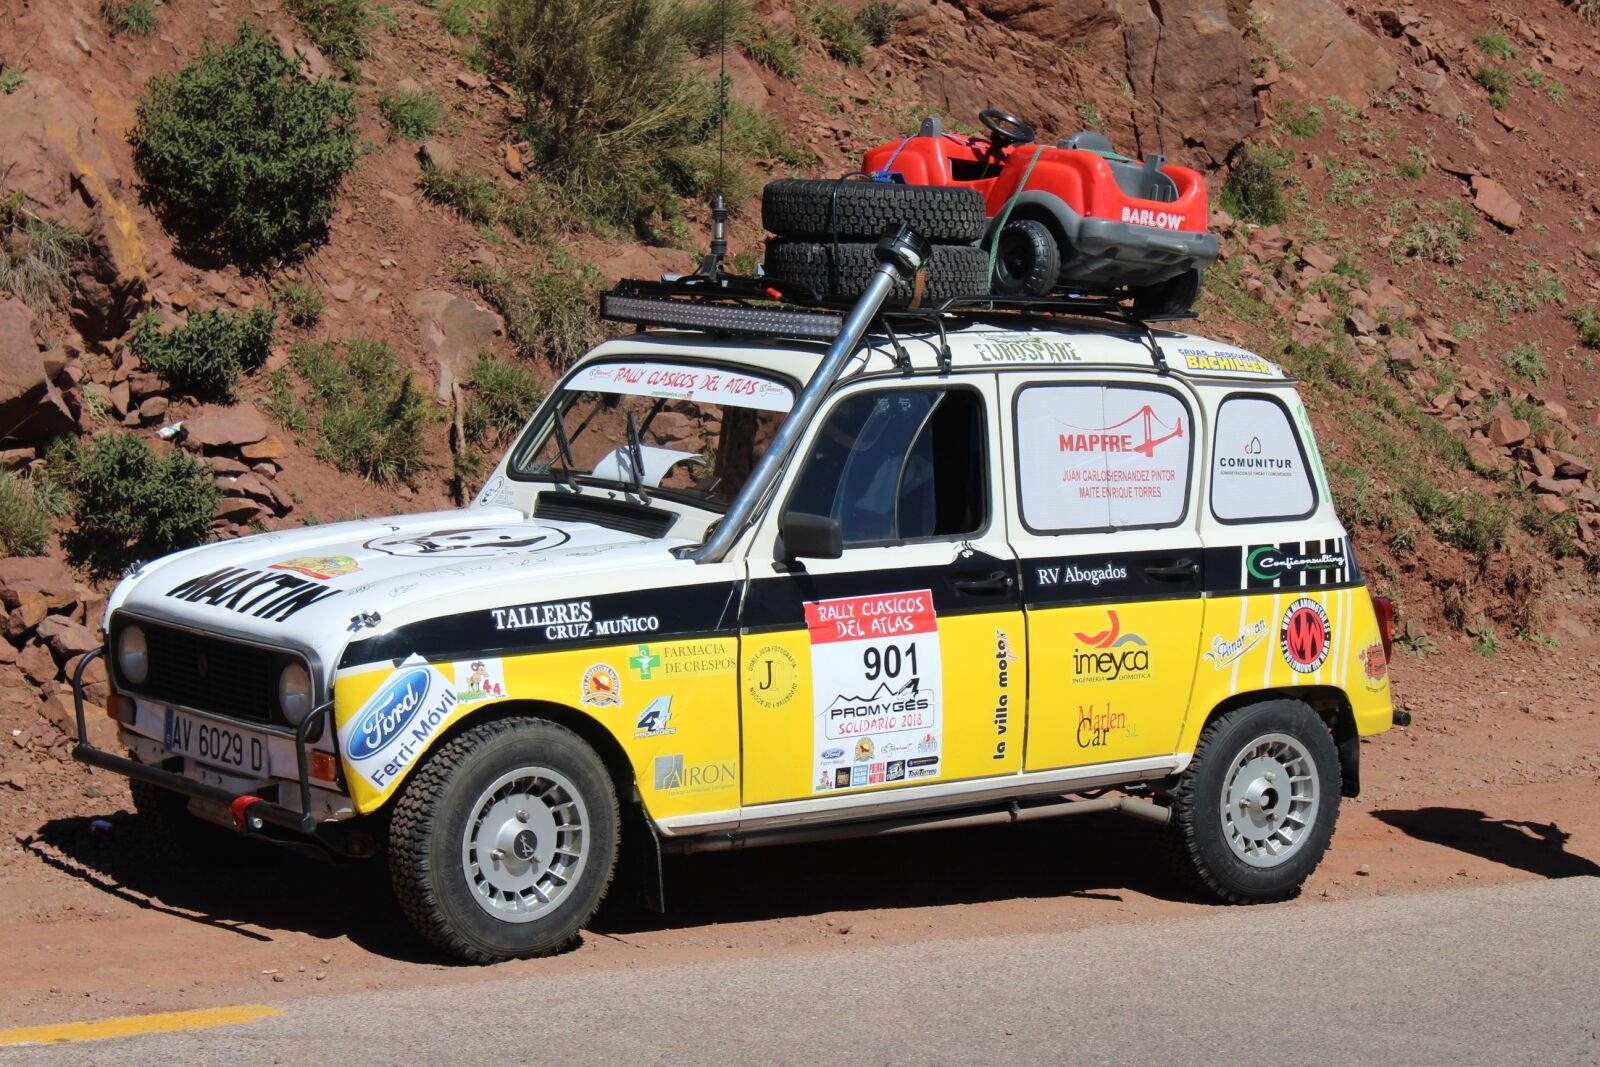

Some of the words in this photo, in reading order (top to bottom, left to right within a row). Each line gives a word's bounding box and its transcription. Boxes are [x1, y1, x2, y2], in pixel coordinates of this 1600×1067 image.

[1121, 206, 1182, 231] BARLOW
[973, 342, 1082, 361] EUROSPARE
[1184, 355, 1273, 376] BACHILLER
[613, 367, 647, 383] RALLY
[647, 370, 699, 388] CLASICOS
[699, 374, 720, 392] DEL
[723, 377, 760, 395] ATLAS
[1059, 434, 1133, 453] MAPFRE
[1219, 457, 1292, 469] COMUNITUR
[1062, 470, 1081, 482] JUAN
[1151, 470, 1176, 481] PINTOR
[1079, 487, 1100, 498] MAITE
[1102, 486, 1133, 498] ENRIQUE
[1134, 487, 1162, 498] TORRES
[1260, 554, 1345, 570] Conficonsulting
[1037, 568, 1060, 585] RV
[1064, 563, 1127, 586] Abogados
[491, 601, 593, 630] TALLERES
[817, 602, 855, 622] RALLY
[862, 597, 925, 616] CLASICOS
[596, 616, 659, 636] MUÑICO
[837, 619, 865, 638] DEL
[871, 615, 915, 635] ATLAS
[664, 643, 726, 658] FARMACIA
[863, 642, 917, 681] 901
[665, 662, 682, 673] DE
[684, 658, 737, 672] CRESPOS
[760, 660, 774, 690] J
[1073, 648, 1149, 681] imeyca
[362, 682, 419, 749] Ford
[830, 698, 929, 720] PROMYGES
[994, 694, 1008, 735] villa
[1078, 702, 1126, 732] Marlen
[838, 716, 897, 735] SOLIDARIO
[901, 713, 922, 728] 2018
[1077, 717, 1110, 748] Car
[173, 715, 192, 751] AV
[199, 724, 243, 766] 6029
[251, 737, 262, 771] D
[371, 688, 457, 787] Ferri-Móvil
[993, 741, 1006, 760] la
[669, 762, 736, 789] AIRON
